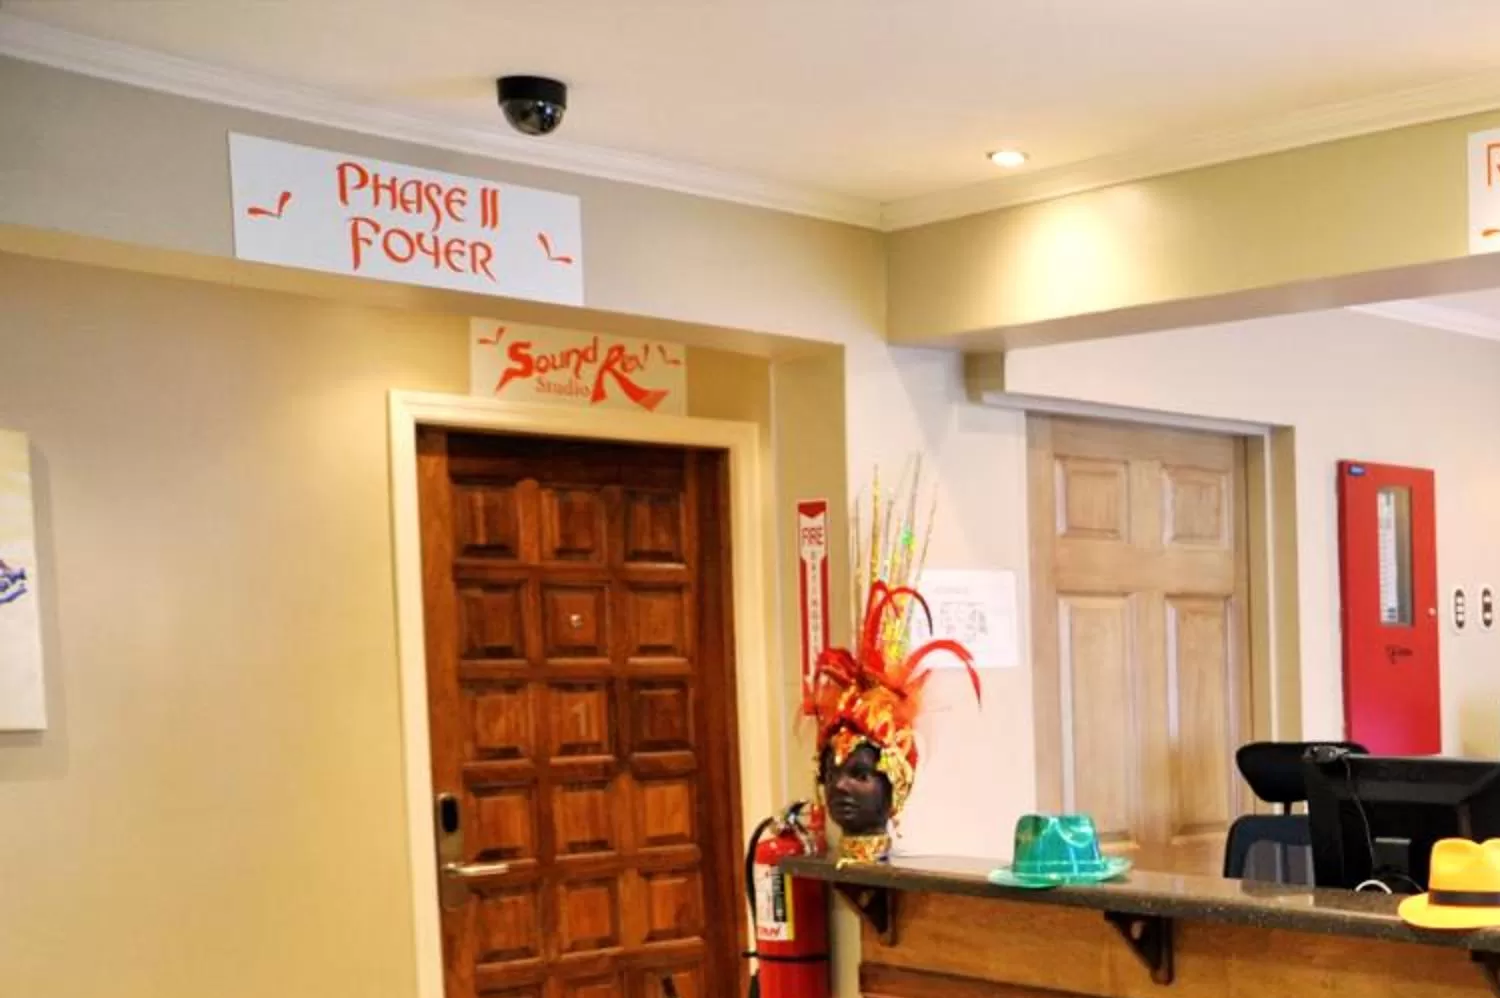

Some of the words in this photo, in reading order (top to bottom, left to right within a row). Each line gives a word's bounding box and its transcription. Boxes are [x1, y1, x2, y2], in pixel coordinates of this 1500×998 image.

[336, 161, 468, 232] PHASE
[348, 216, 497, 282] FOYER
[495, 336, 599, 392] Sound
[801, 527, 824, 545] FIRE
